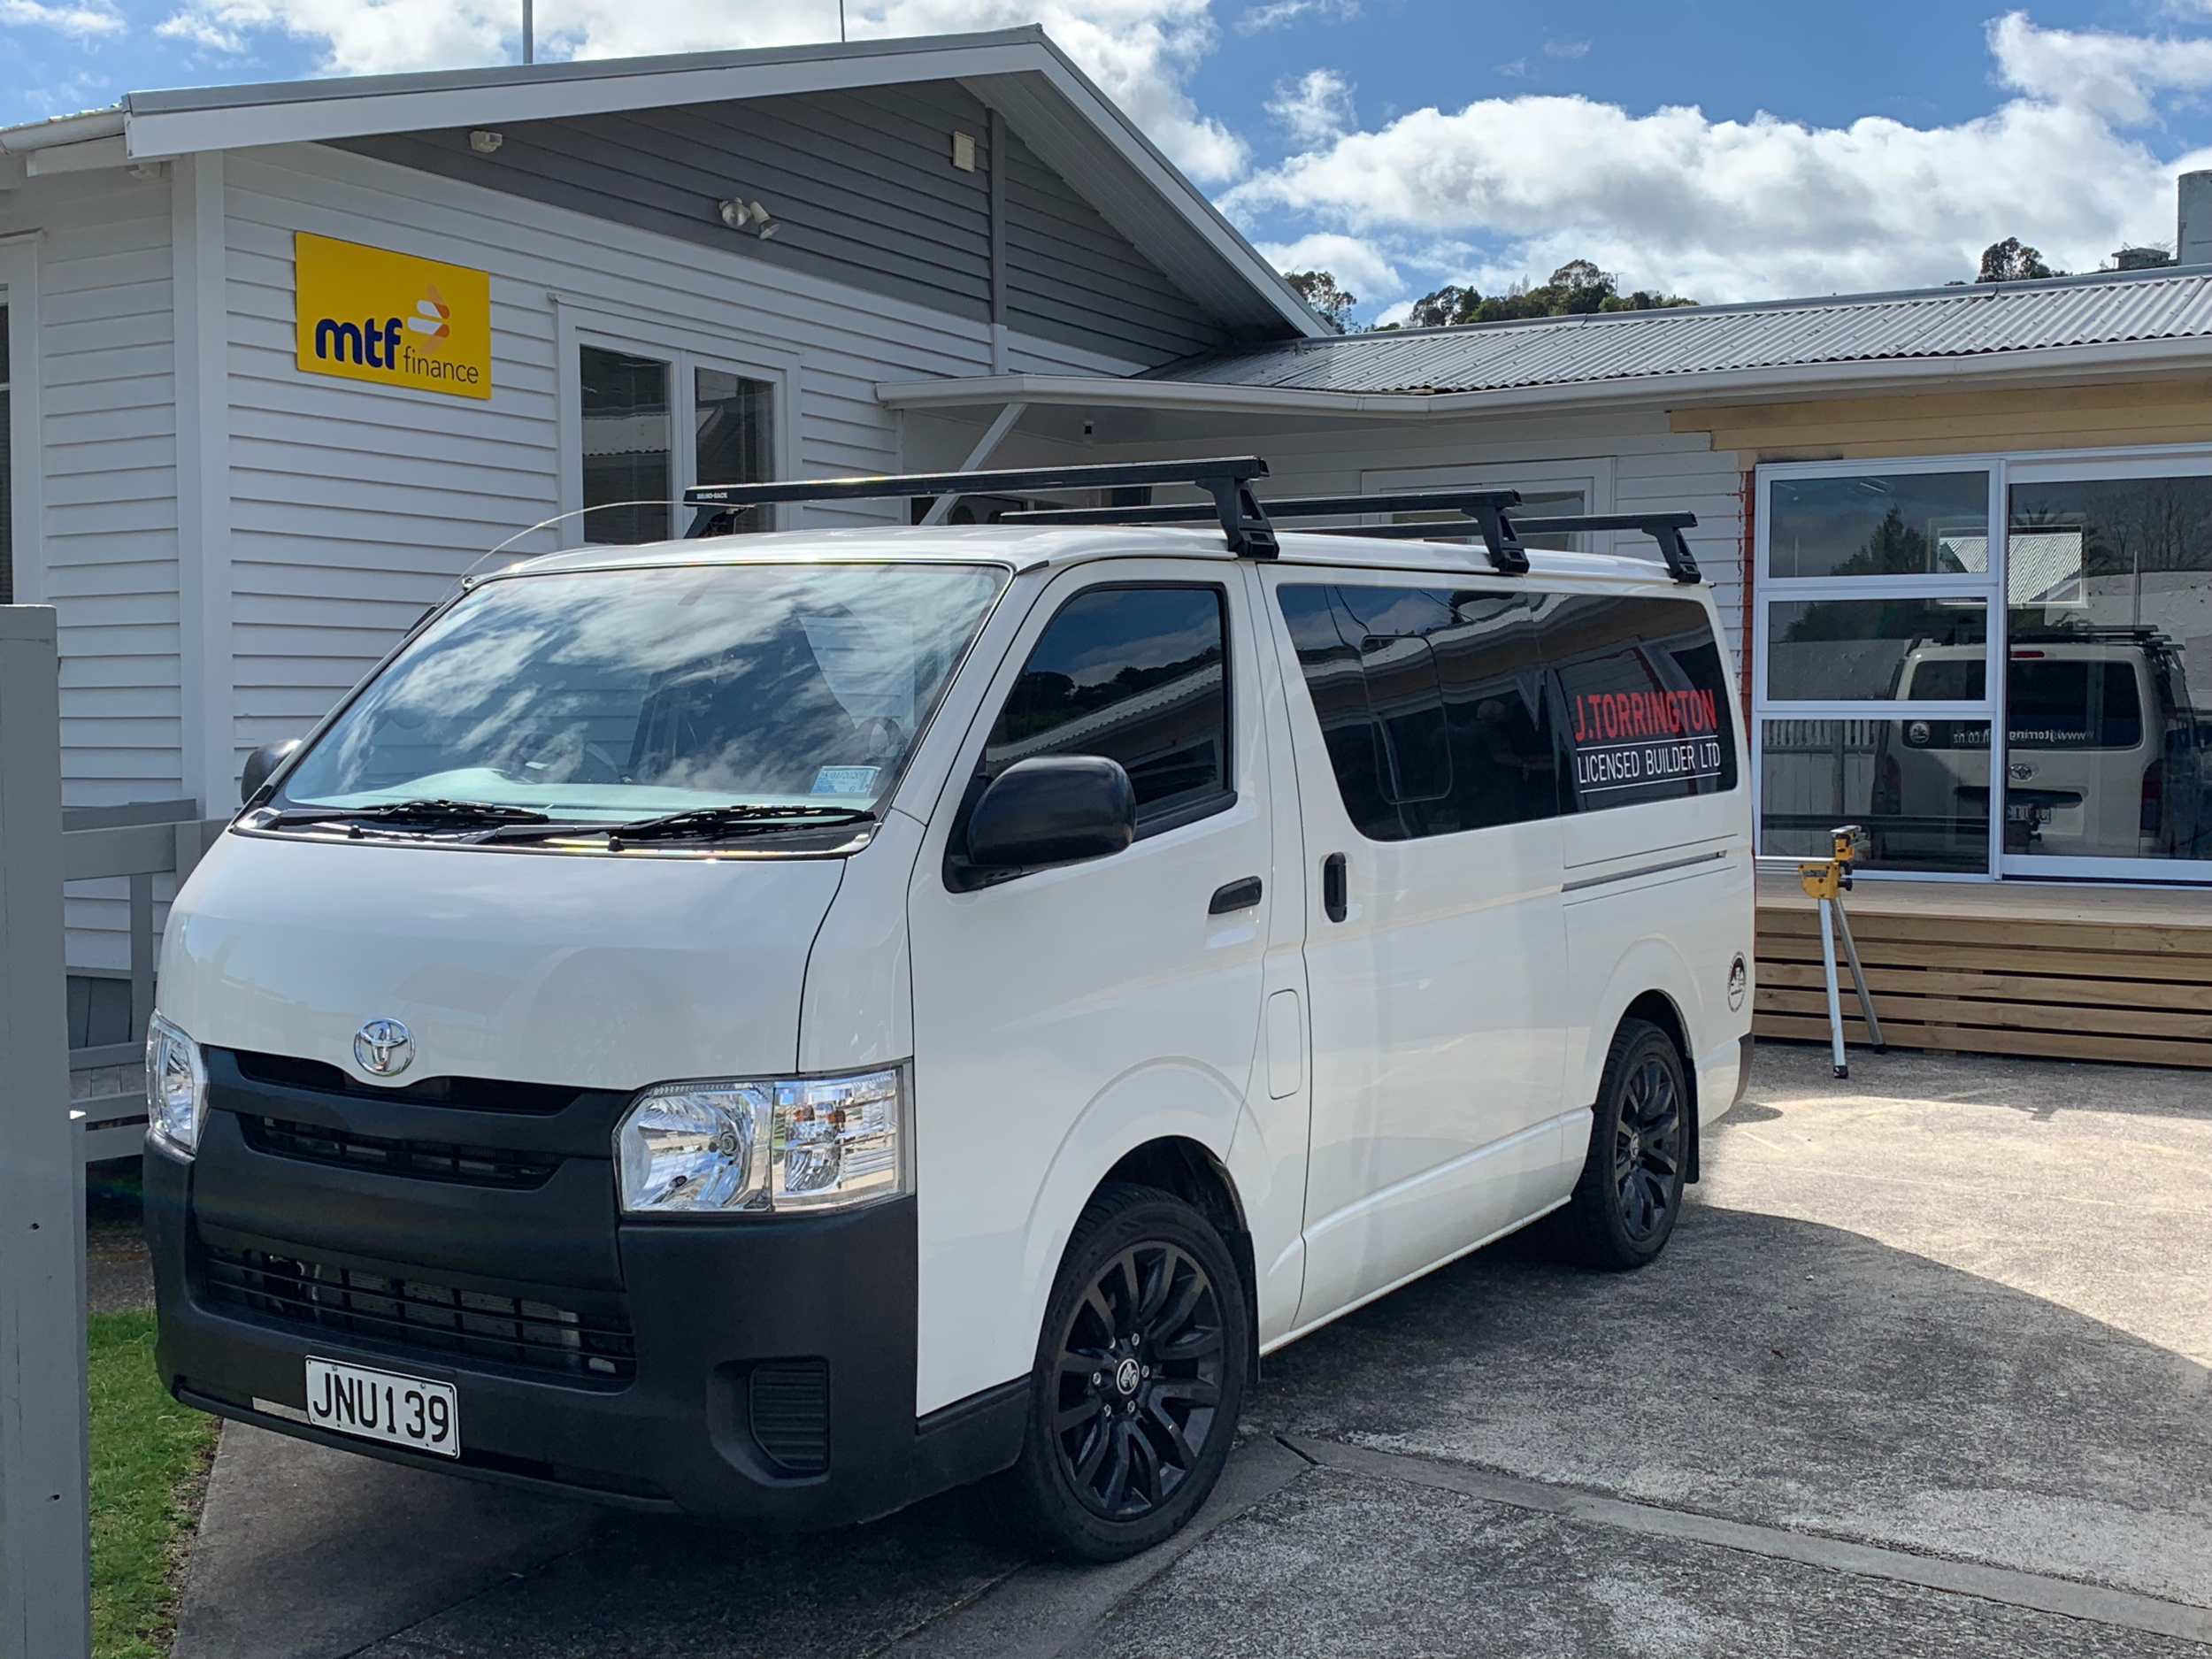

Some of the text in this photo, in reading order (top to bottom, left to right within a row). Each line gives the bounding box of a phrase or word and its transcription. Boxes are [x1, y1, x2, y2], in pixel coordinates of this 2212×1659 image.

[315, 317, 479, 385] mtf finance
[1575, 688, 1718, 741] J.TORRINGTON
[1578, 742, 1722, 784] LICENSED BUILDER LTD
[312, 1372, 449, 1443] JNU139
